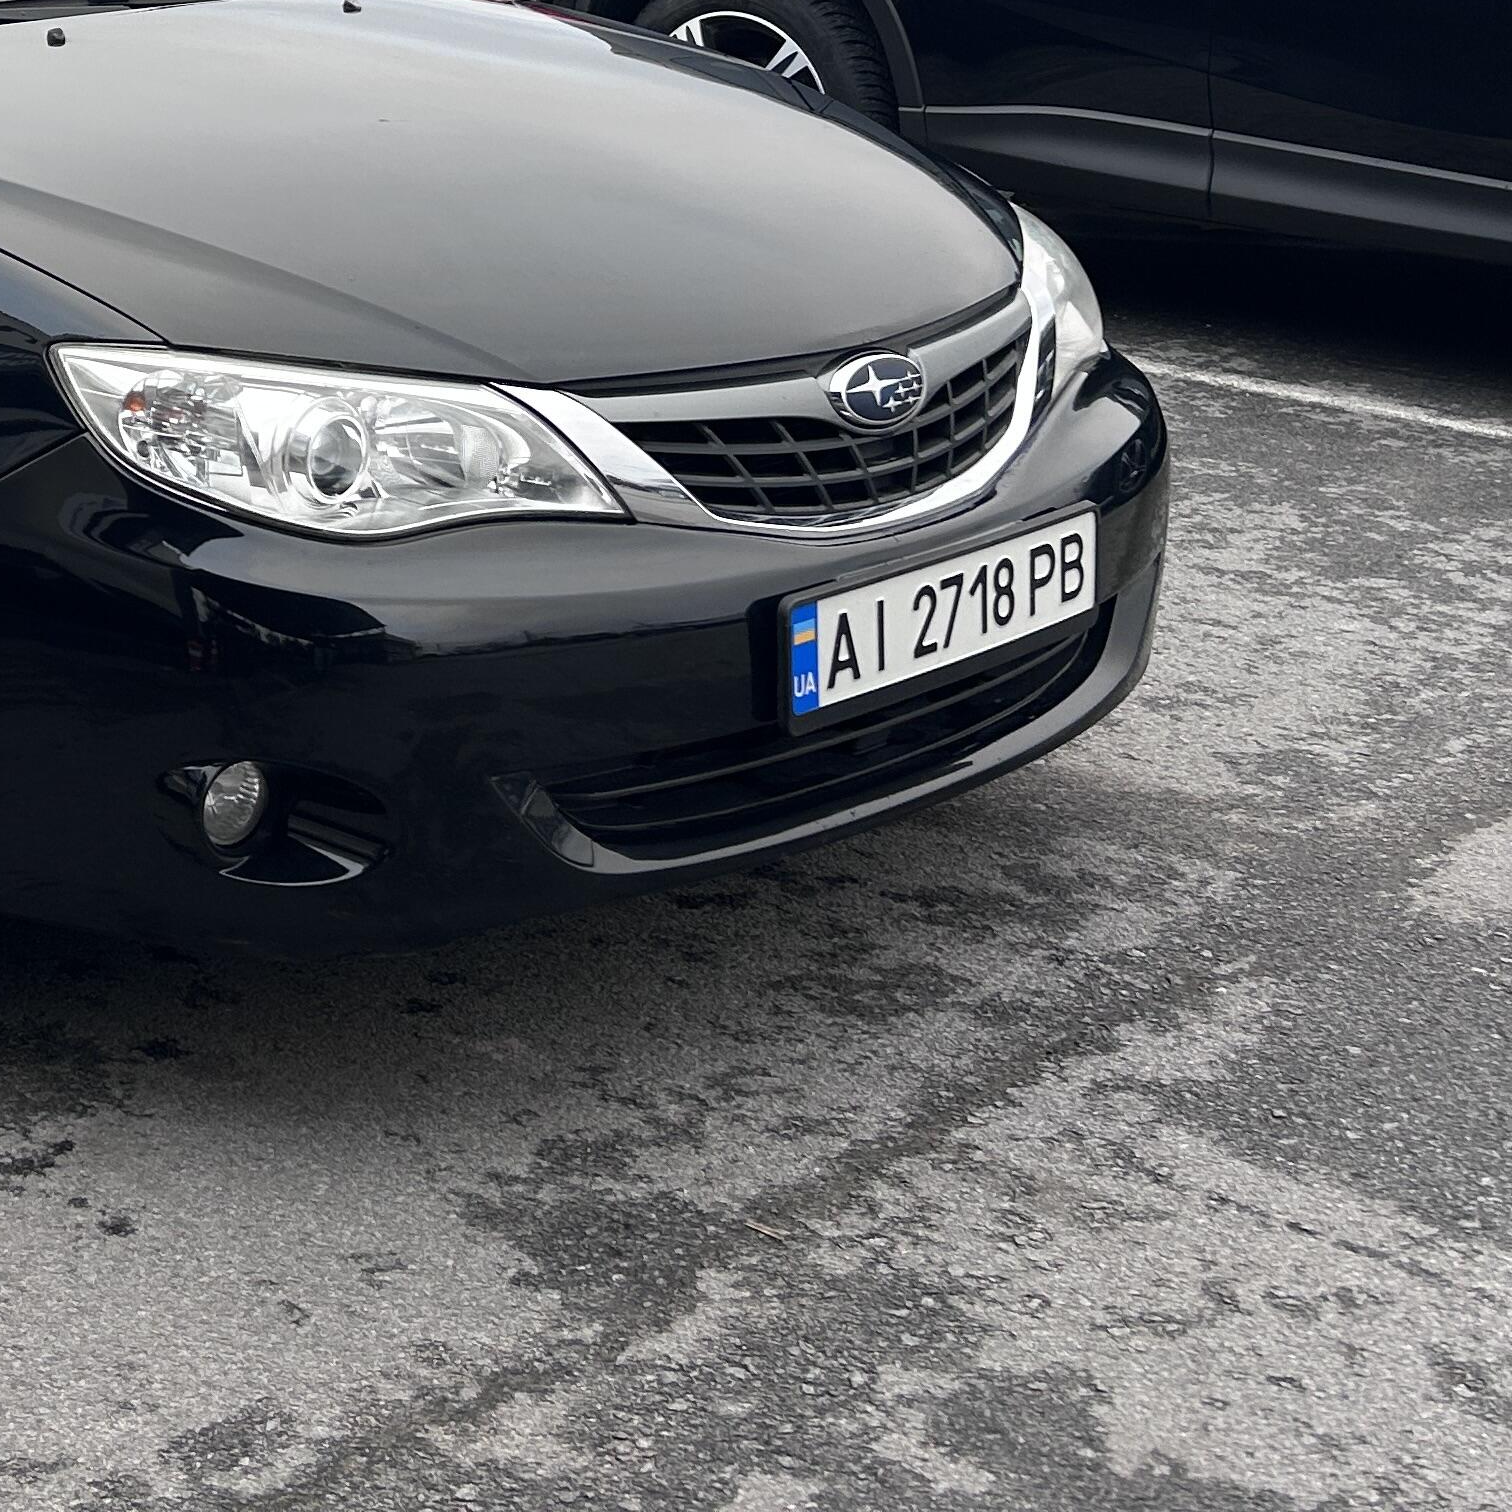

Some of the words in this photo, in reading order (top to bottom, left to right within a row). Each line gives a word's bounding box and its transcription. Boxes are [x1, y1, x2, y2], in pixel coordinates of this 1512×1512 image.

[827, 599, 885, 689] AI
[913, 557, 1015, 658] 2718
[1029, 532, 1084, 617] PB
[793, 671, 816, 697] UA
